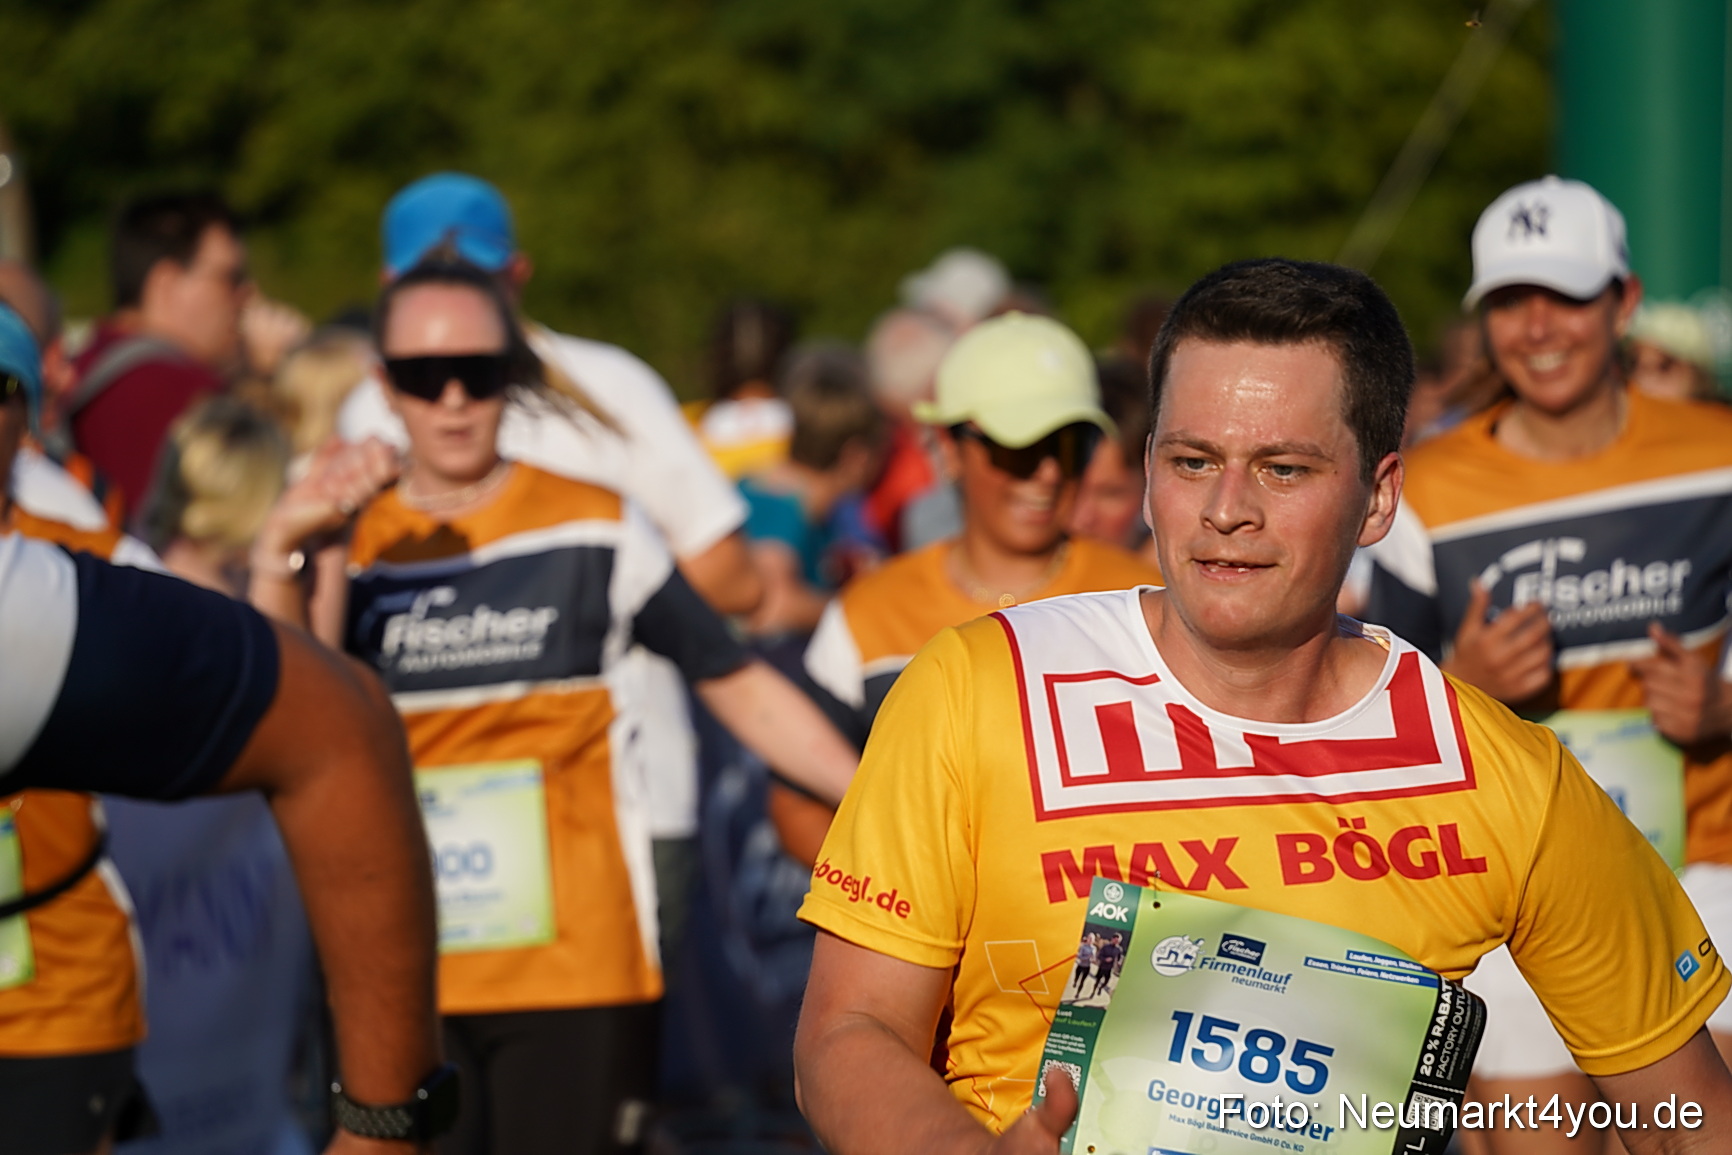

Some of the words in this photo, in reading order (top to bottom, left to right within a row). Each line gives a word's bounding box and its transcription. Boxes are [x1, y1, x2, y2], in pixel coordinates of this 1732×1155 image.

[1512, 552, 1693, 612] Fischer
[381, 597, 559, 658] Fischer
[1040, 837, 1249, 904] MAX
[1276, 816, 1488, 886] BÖGL
[814, 857, 911, 919] -boegl.de
[1089, 902, 1130, 923] AOK
[1199, 957, 1293, 985] Firmenlauf
[1231, 975, 1286, 994] neumarkt
[1167, 1010, 1334, 1095] 1585
[1420, 1052, 1435, 1077] 20
[1426, 1038, 1440, 1051] %
[1435, 1025, 1459, 1080] FACTORY
[1148, 1079, 1222, 1120] Georg
[1168, 1113, 1185, 1124] Max
[1187, 1118, 1205, 1129] Bögl
[1249, 1132, 1273, 1145] GmbH
